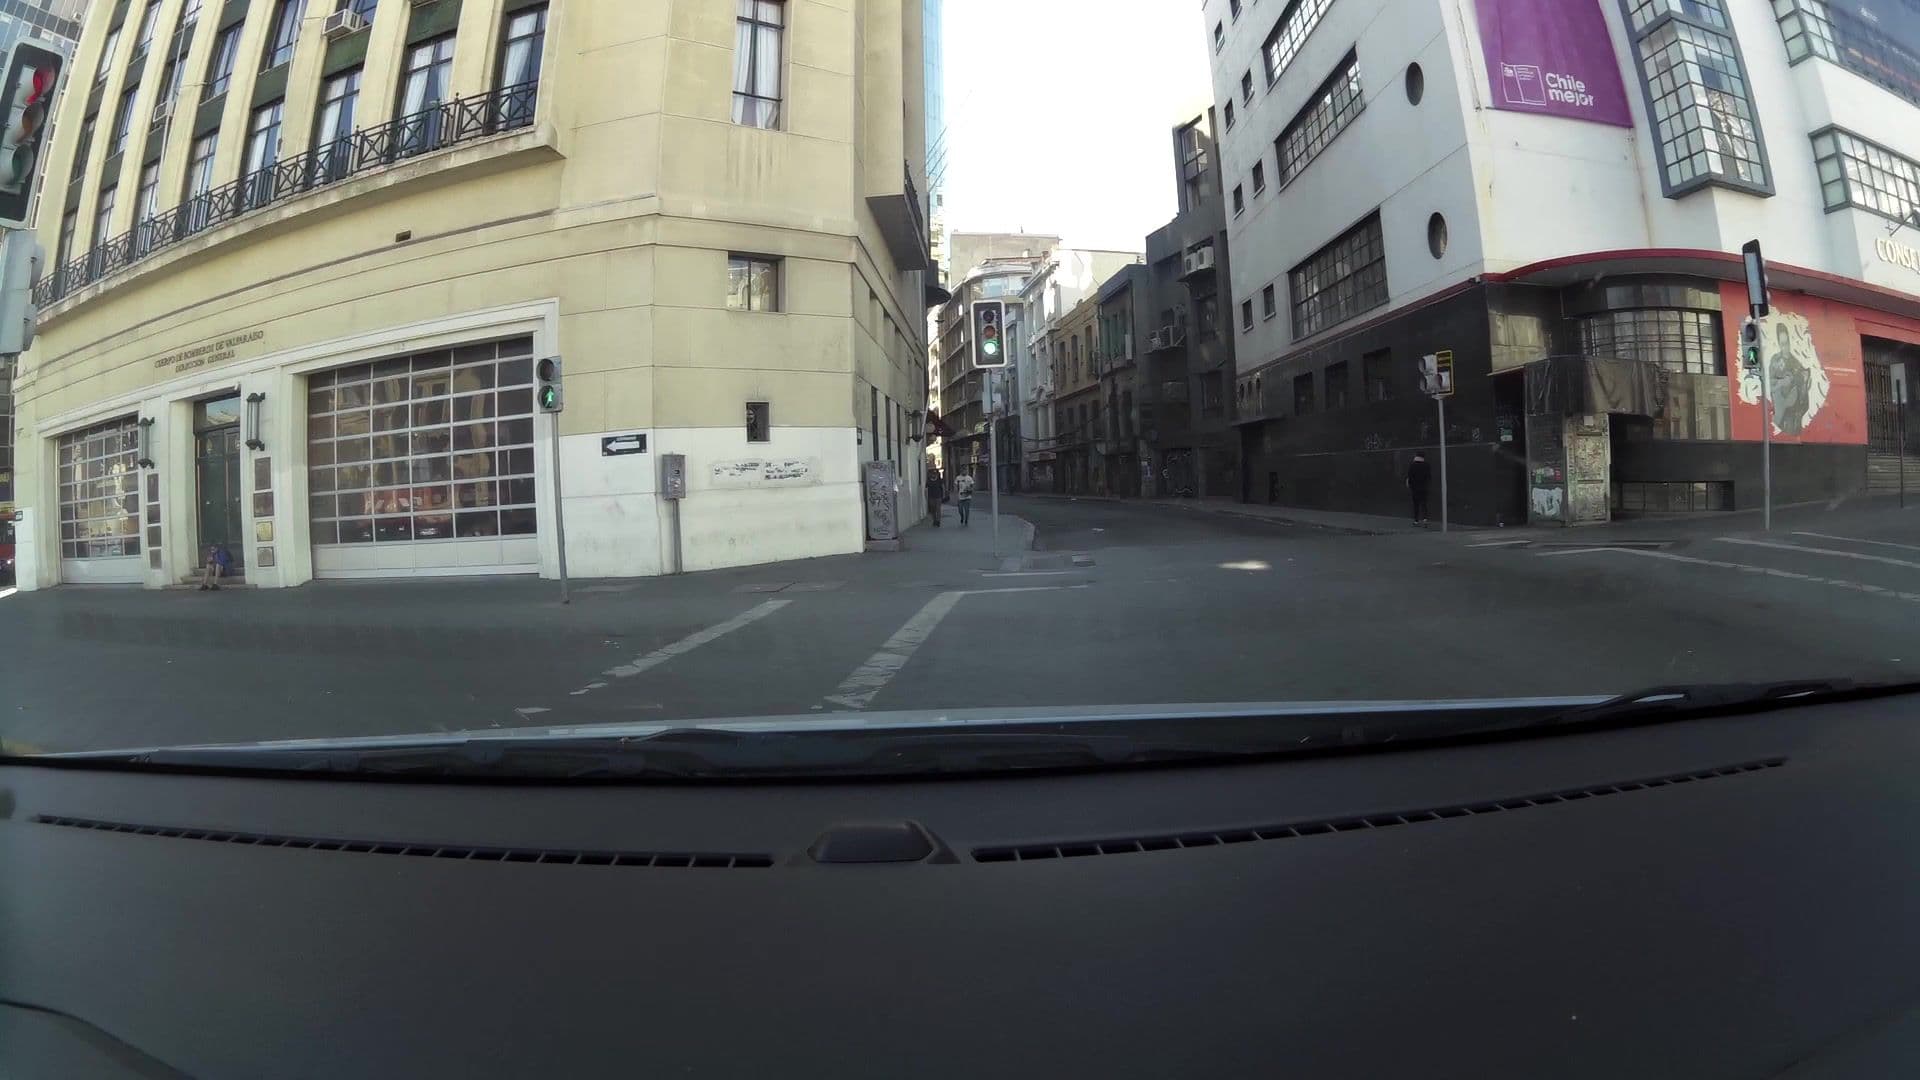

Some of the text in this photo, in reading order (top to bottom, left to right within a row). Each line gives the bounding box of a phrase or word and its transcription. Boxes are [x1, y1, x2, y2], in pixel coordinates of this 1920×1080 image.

[1545, 72, 1586, 93] Chile
[1548, 88, 1594, 106] mejor
[1874, 235, 1920, 273] CONSE
